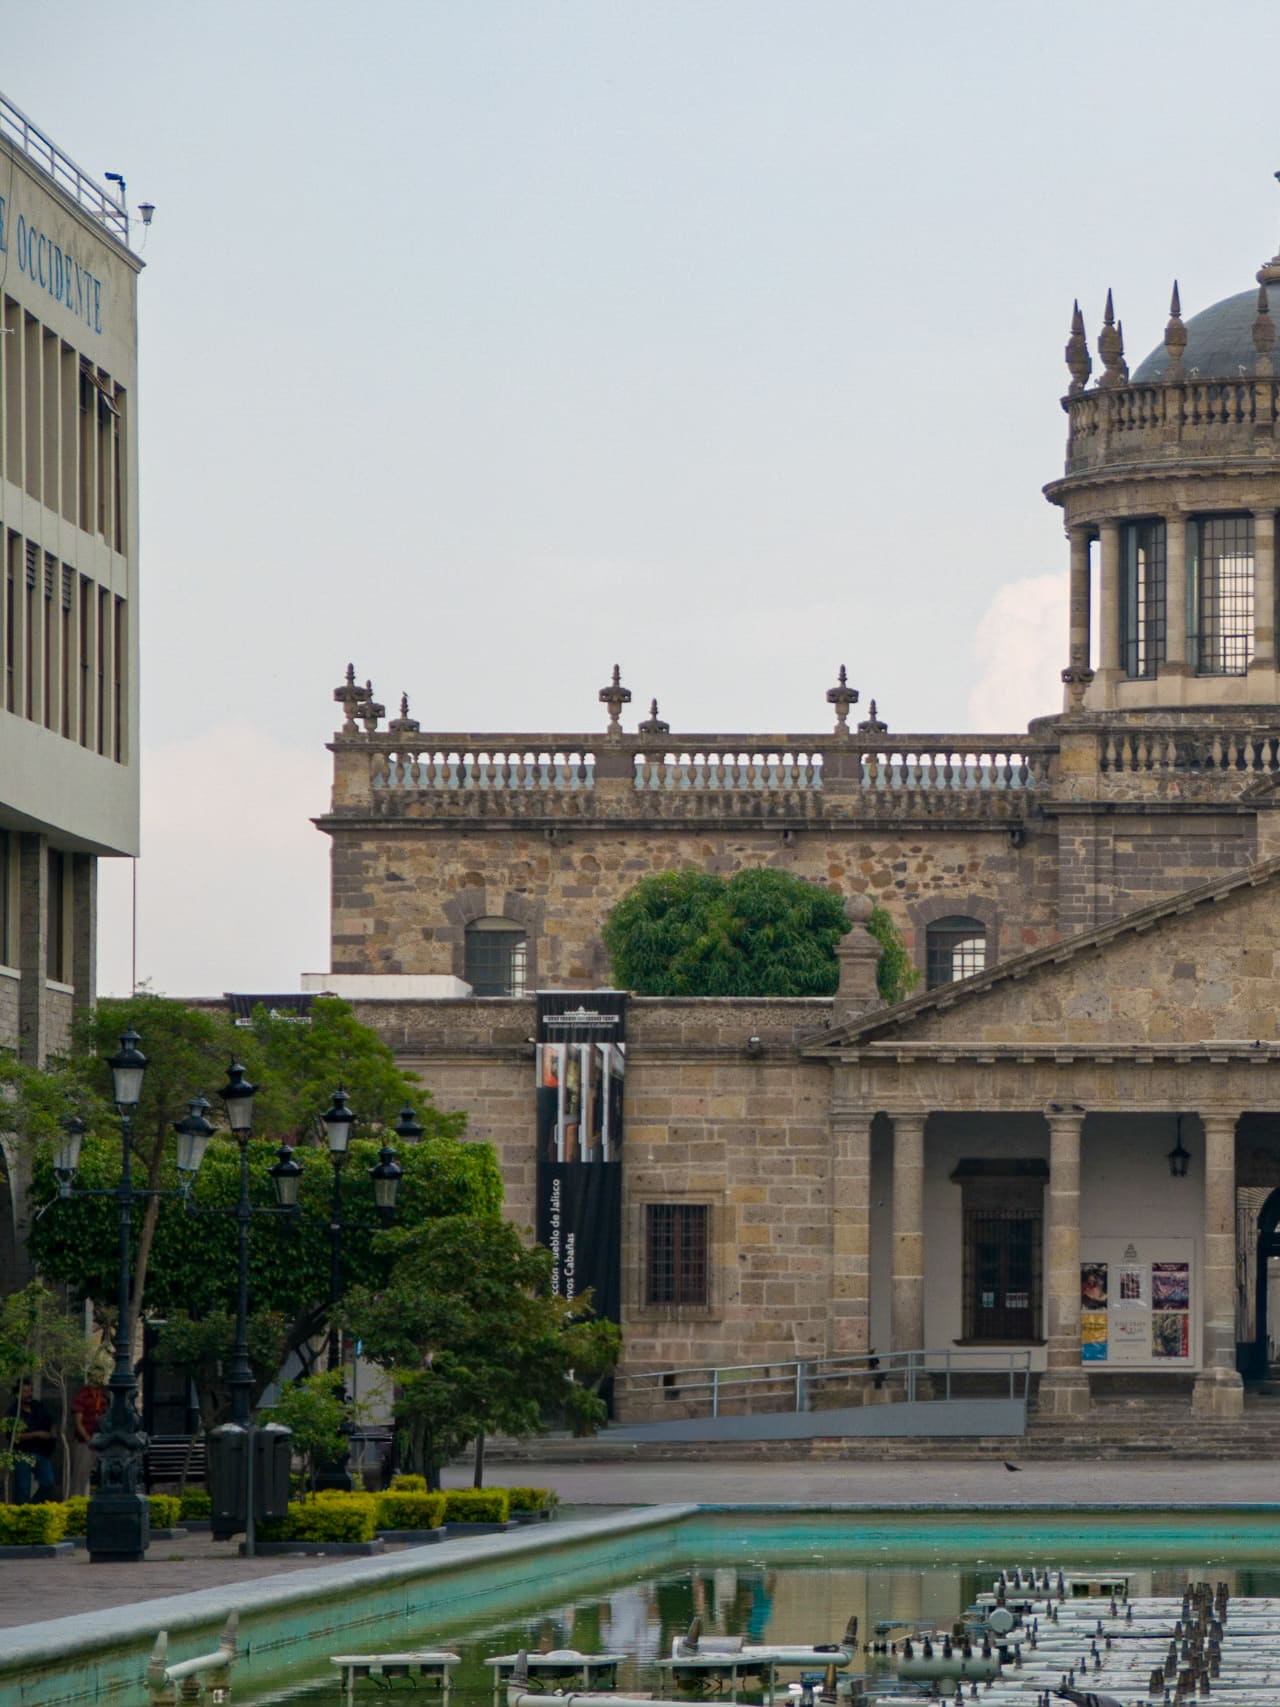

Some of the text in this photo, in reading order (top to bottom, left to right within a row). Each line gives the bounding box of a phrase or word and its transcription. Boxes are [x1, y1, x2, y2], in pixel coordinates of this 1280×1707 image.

[17, 213, 102, 335] OCCIDENTE
[550, 1179, 560, 1212] Jalisco
[550, 1214, 560, 1228] de
[550, 1230, 560, 1265] ueblo
[563, 1232, 575, 1276] Cabañas
